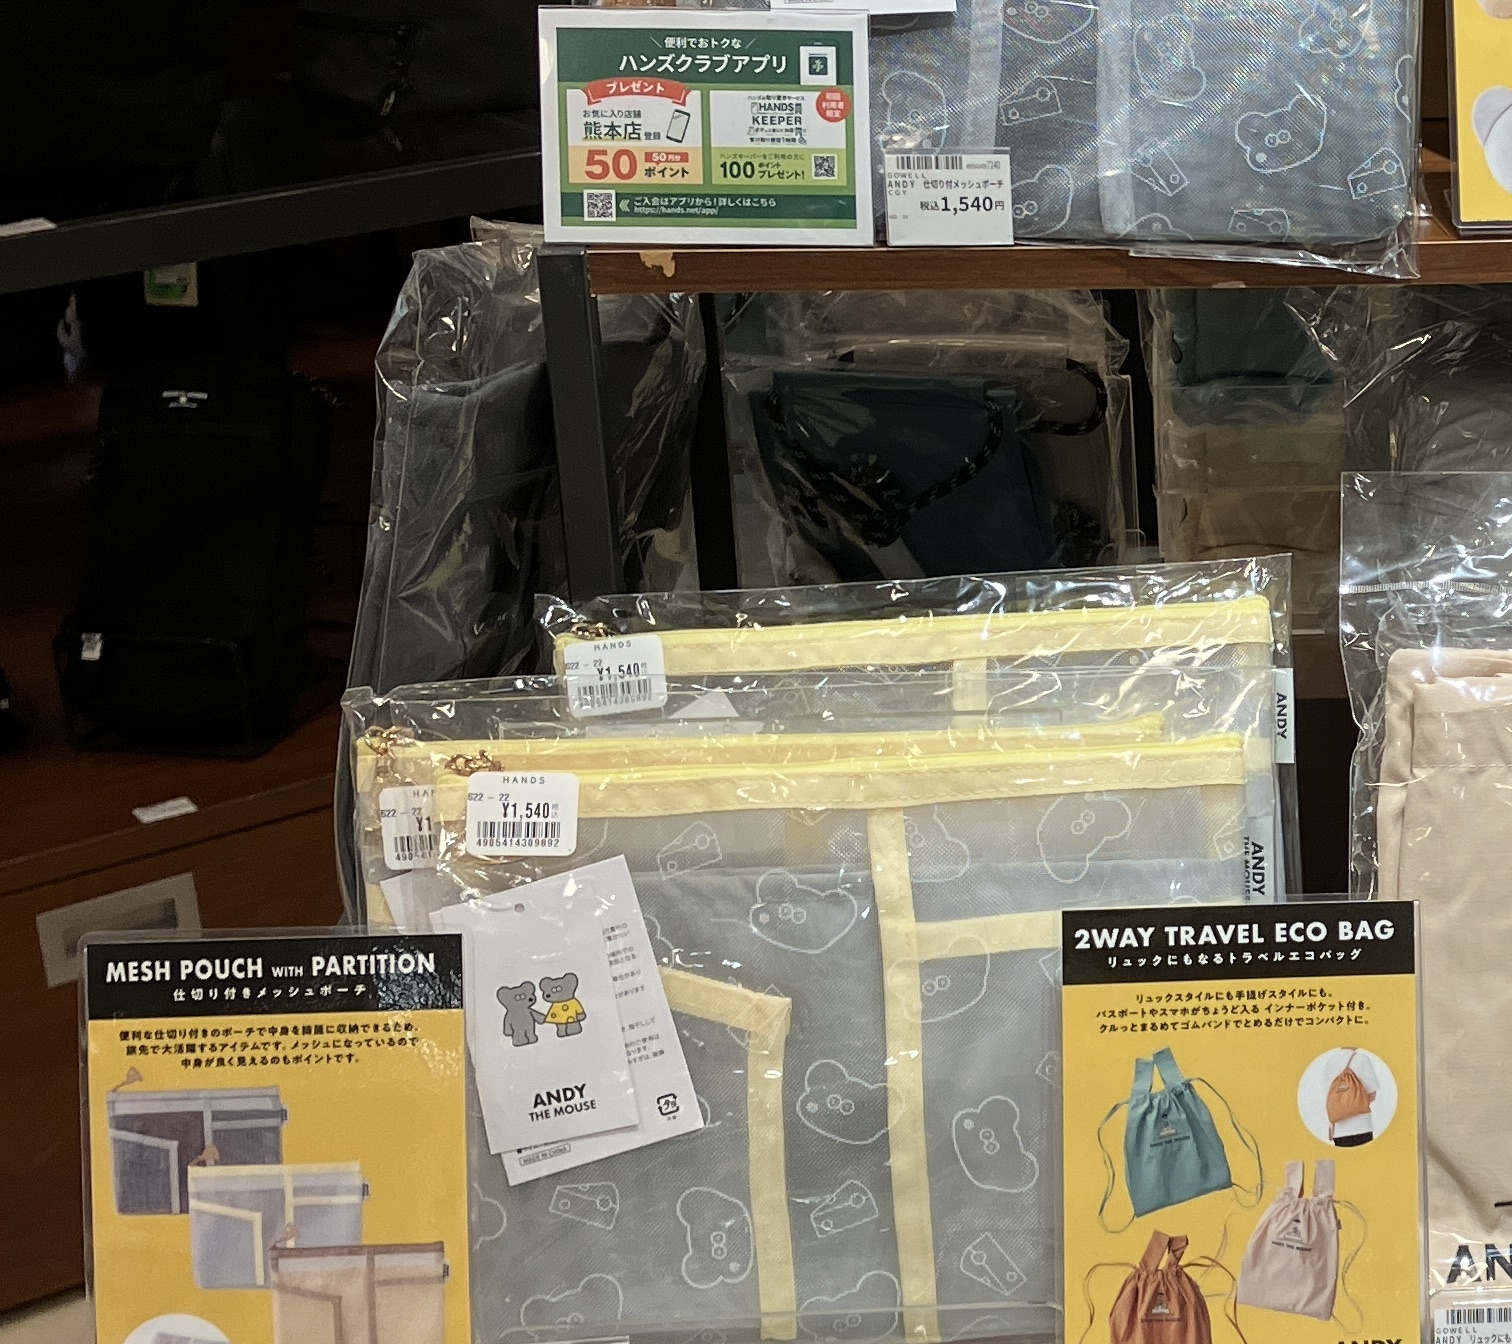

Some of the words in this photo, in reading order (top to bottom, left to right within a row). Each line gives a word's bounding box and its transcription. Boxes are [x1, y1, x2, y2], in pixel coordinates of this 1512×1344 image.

[664, 37, 741, 49] 便利でおトクな
[619, 54, 787, 73] ハンズクラブアプリ
[606, 80, 665, 94] プレゼント
[583, 109, 641, 119] お気に入り店舗
[759, 103, 794, 112] HANDS
[752, 116, 802, 126] KEEPER
[583, 121, 642, 141] 熊本店
[585, 149, 638, 180] 50
[644, 167, 689, 178] ポイント
[720, 161, 755, 178] 100
[594, 640, 632, 651] HANDS
[1276, 692, 1287, 740] ANDY
[503, 776, 545, 784] HANDS
[502, 803, 550, 821] ¥1,540
[1251, 841, 1265, 896] ANDY
[1074, 927, 1154, 949] 2WAY
[1165, 923, 1265, 946] TRAVEL
[1275, 922, 1327, 943] ECO
[1338, 919, 1395, 941] BAG
[1108, 948, 1363, 968] リュックにもなるトラベルエコバッグ
[106, 960, 171, 983] MESH
[180, 958, 263, 981] POUCH
[272, 966, 303, 978] WITH
[312, 953, 436, 976] PARTITION
[173, 984, 367, 1002] 仕切り付きメッシュポーチ
[532, 1083, 587, 1109] ANDY
[529, 1108, 551, 1122] THE
[554, 1099, 596, 1117] MOUSE
[1435, 1336, 1462, 1344] ANDY
